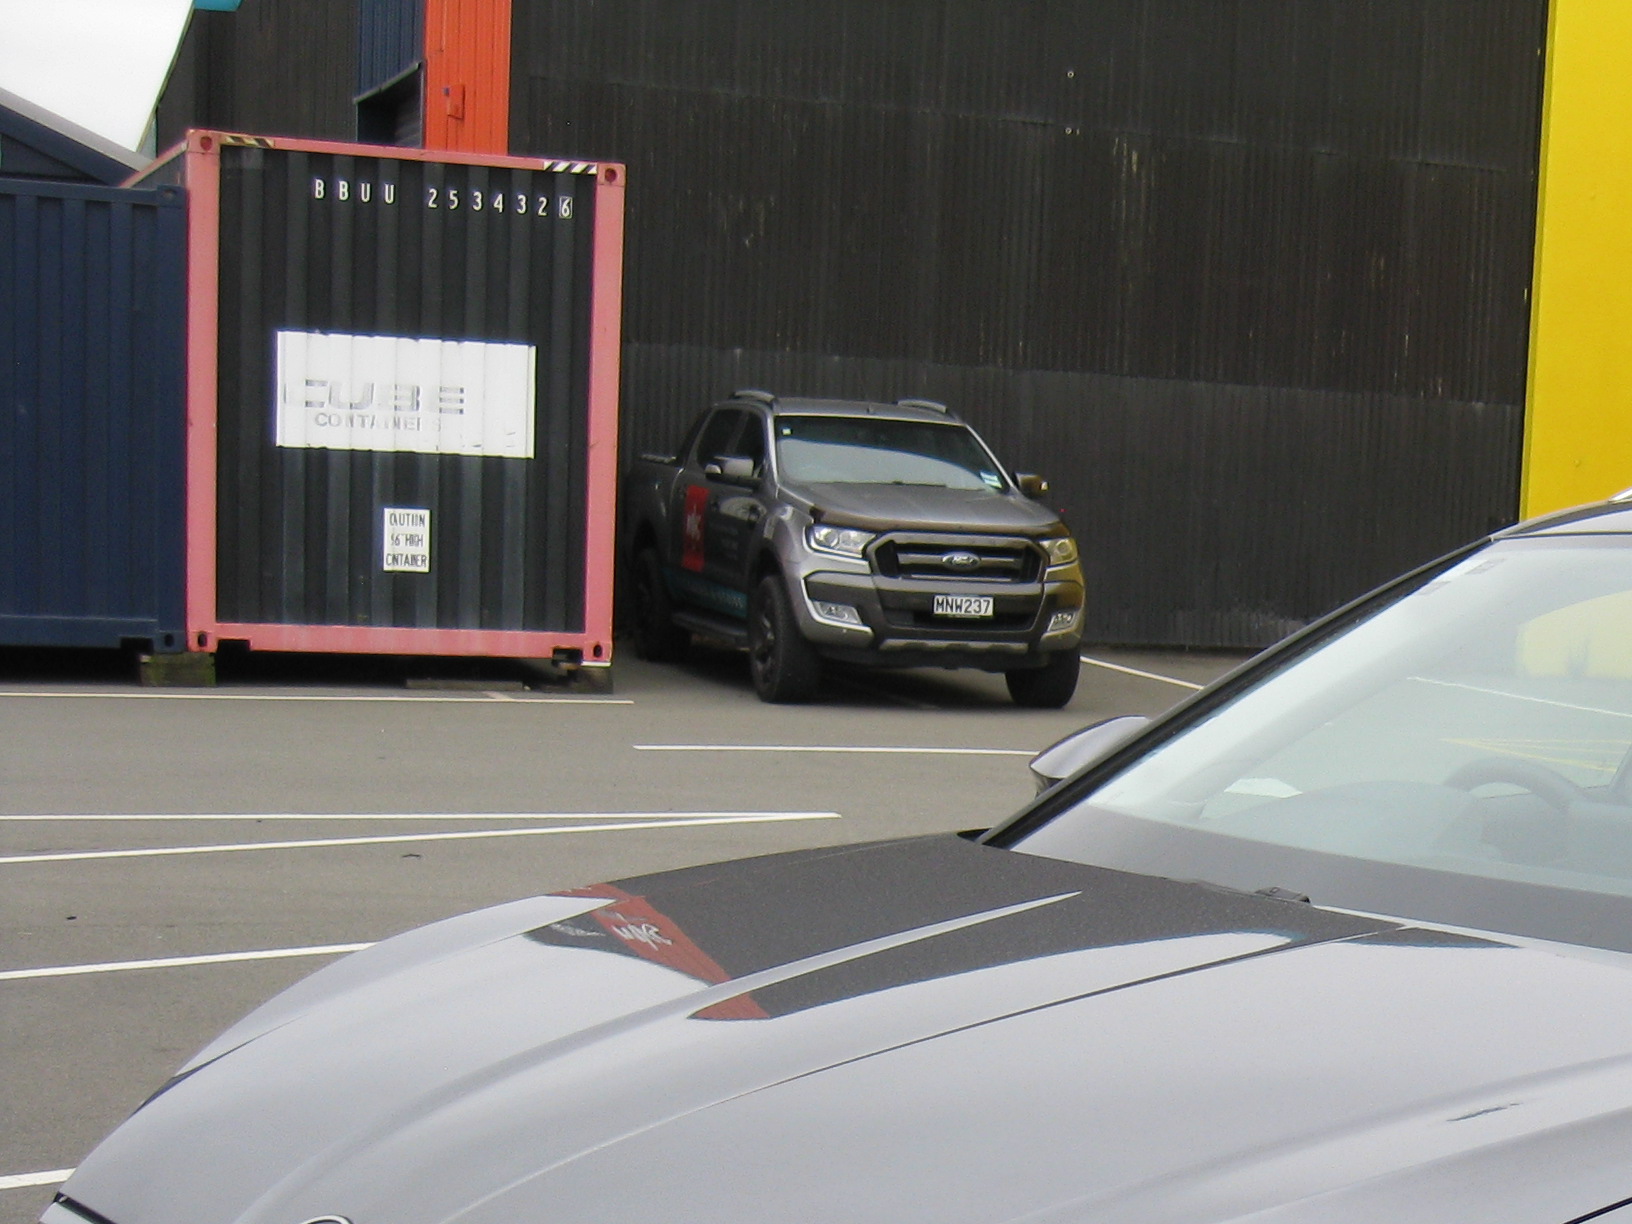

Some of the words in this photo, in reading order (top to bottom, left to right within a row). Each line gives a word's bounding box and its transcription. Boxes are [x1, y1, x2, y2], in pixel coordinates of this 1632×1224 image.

[315, 179, 395, 204] BBUU
[284, 378, 465, 416] CUBE
[385, 553, 427, 569] CNTAINER
[935, 596, 991, 614] MNW237
